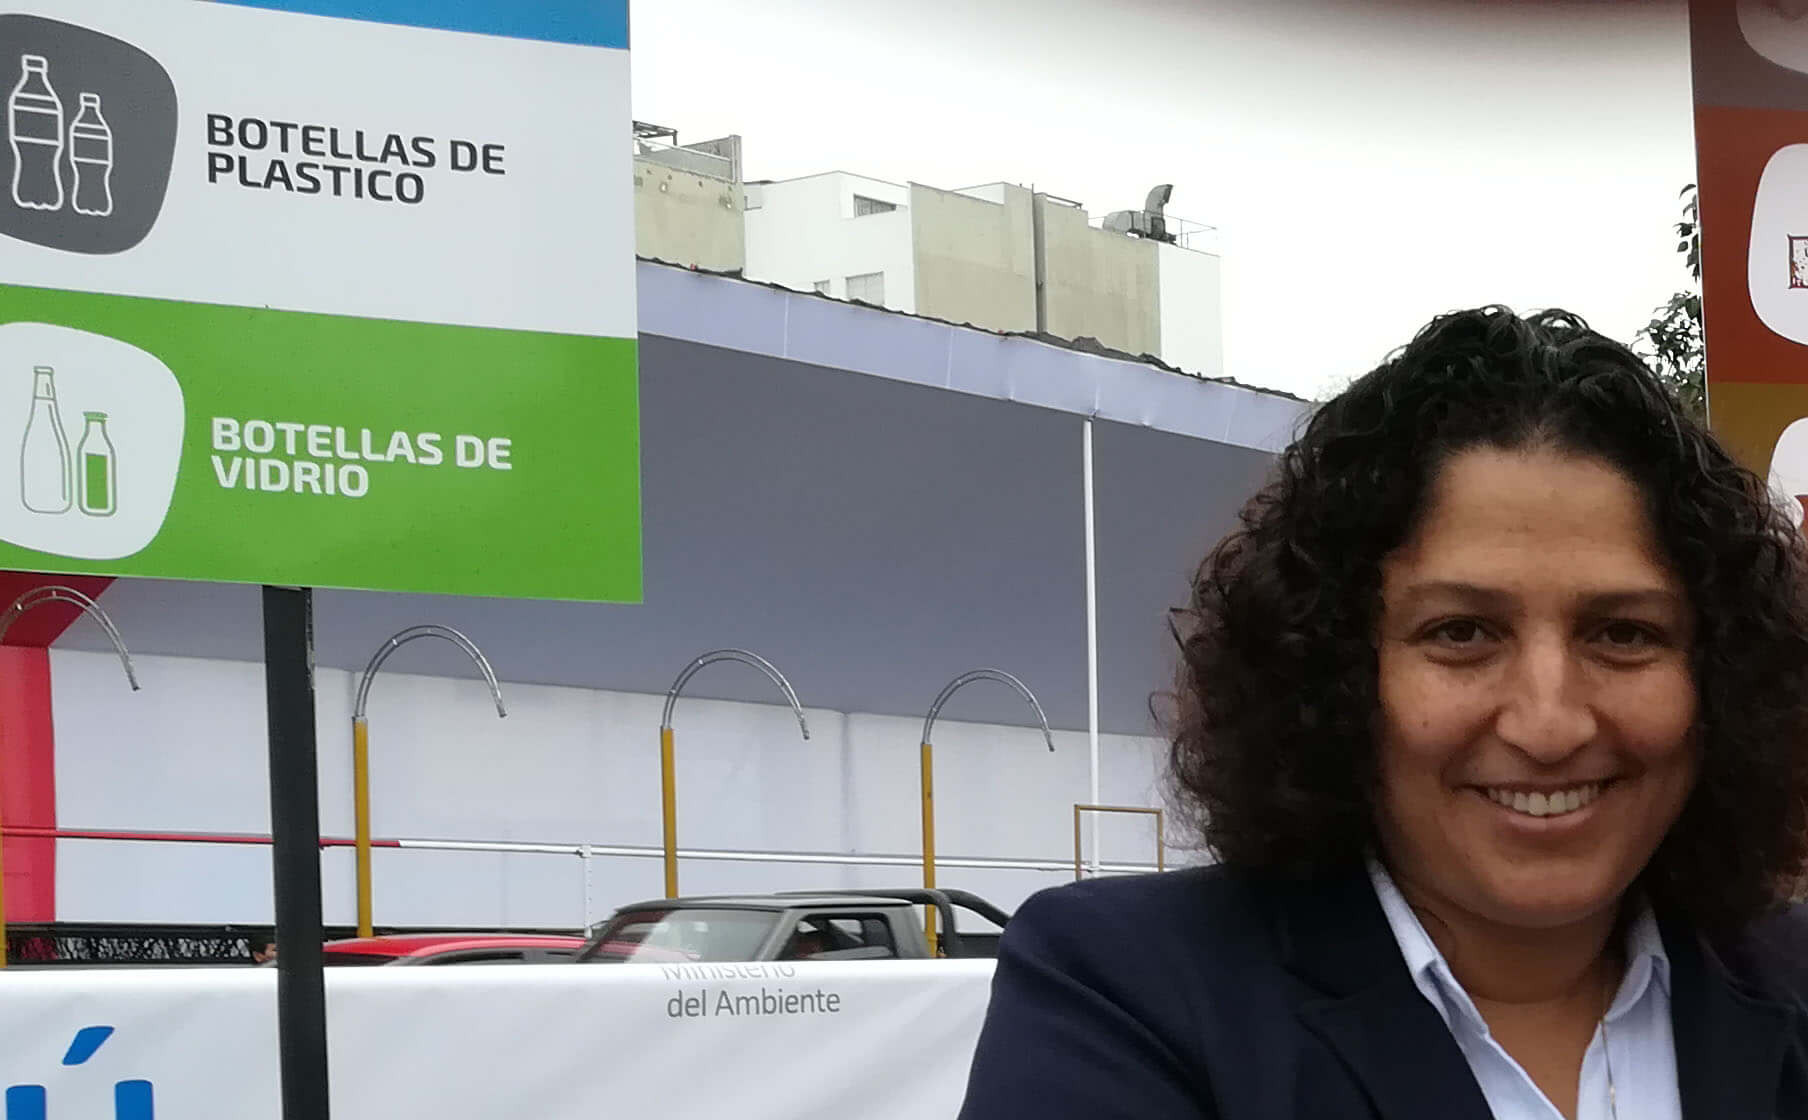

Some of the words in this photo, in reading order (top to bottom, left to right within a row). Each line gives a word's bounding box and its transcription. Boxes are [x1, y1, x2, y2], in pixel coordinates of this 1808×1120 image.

[206, 112, 436, 169] BOTELLAS
[448, 139, 506, 175] DE
[206, 152, 425, 204] PLASTICO
[210, 416, 443, 467] BOTELLAS
[455, 435, 513, 471] DE
[211, 455, 370, 498] VIDRIO
[667, 989, 707, 1018] del
[715, 987, 841, 1016] Ambiente
